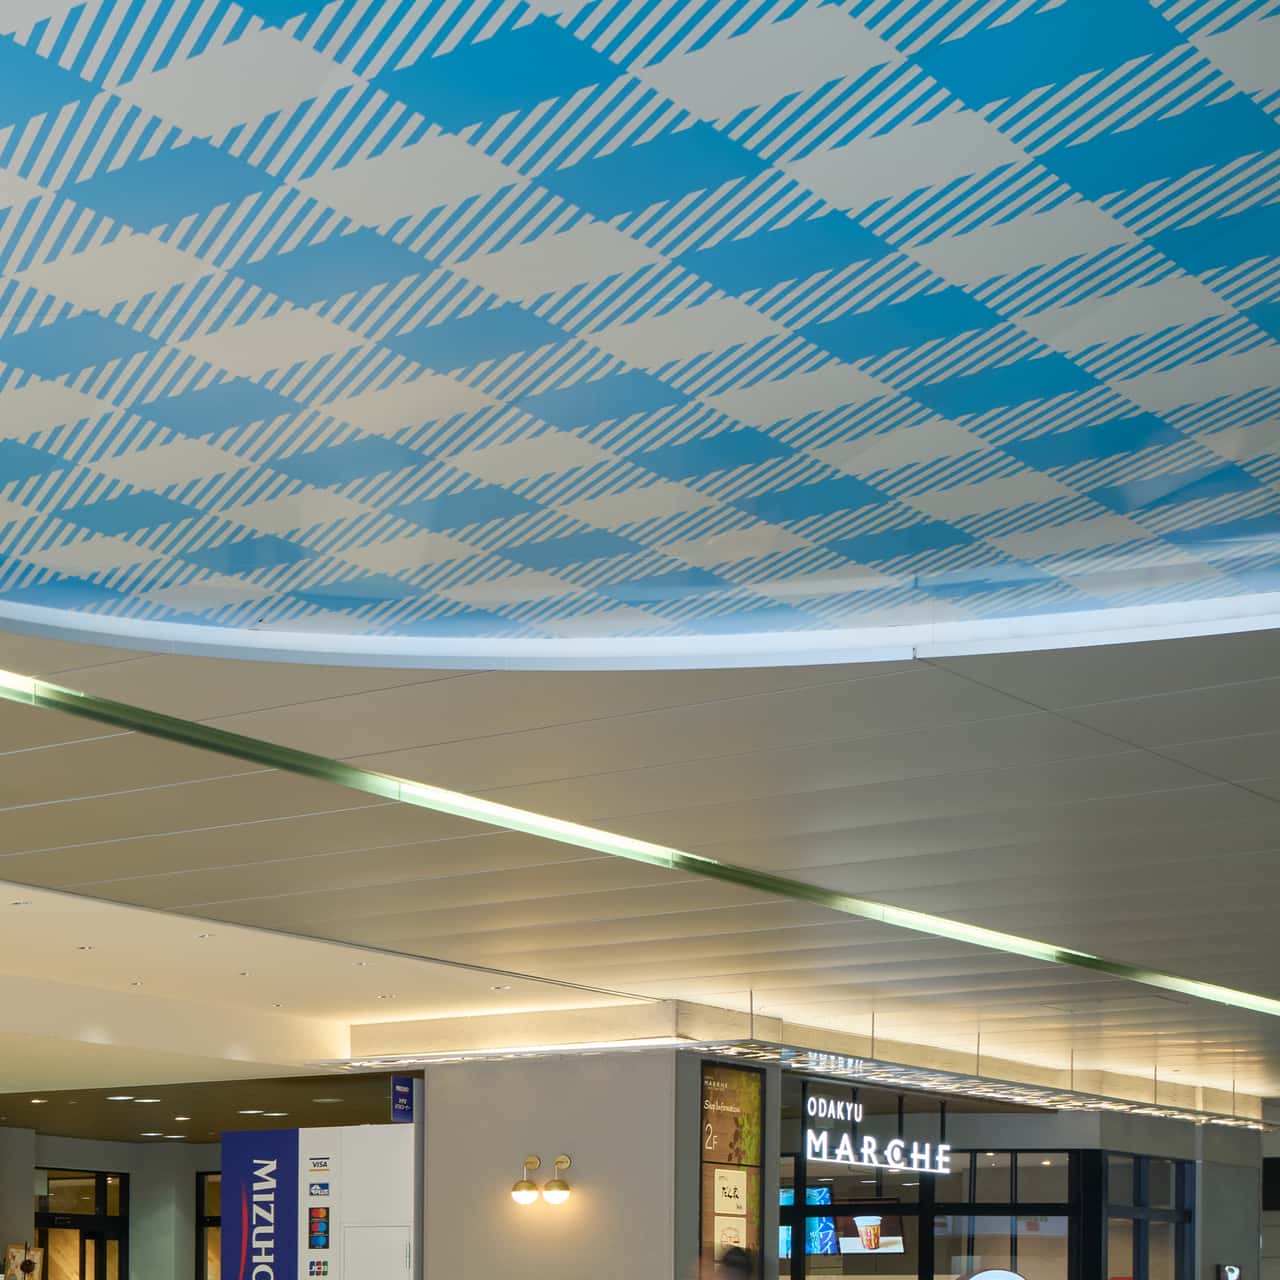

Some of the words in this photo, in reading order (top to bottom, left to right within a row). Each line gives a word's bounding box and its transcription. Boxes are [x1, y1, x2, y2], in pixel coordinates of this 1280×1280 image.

[808, 1096, 863, 1123] ODAKYU
[705, 1123, 718, 1150] 2F
[807, 1129, 951, 1174] MARCHE
